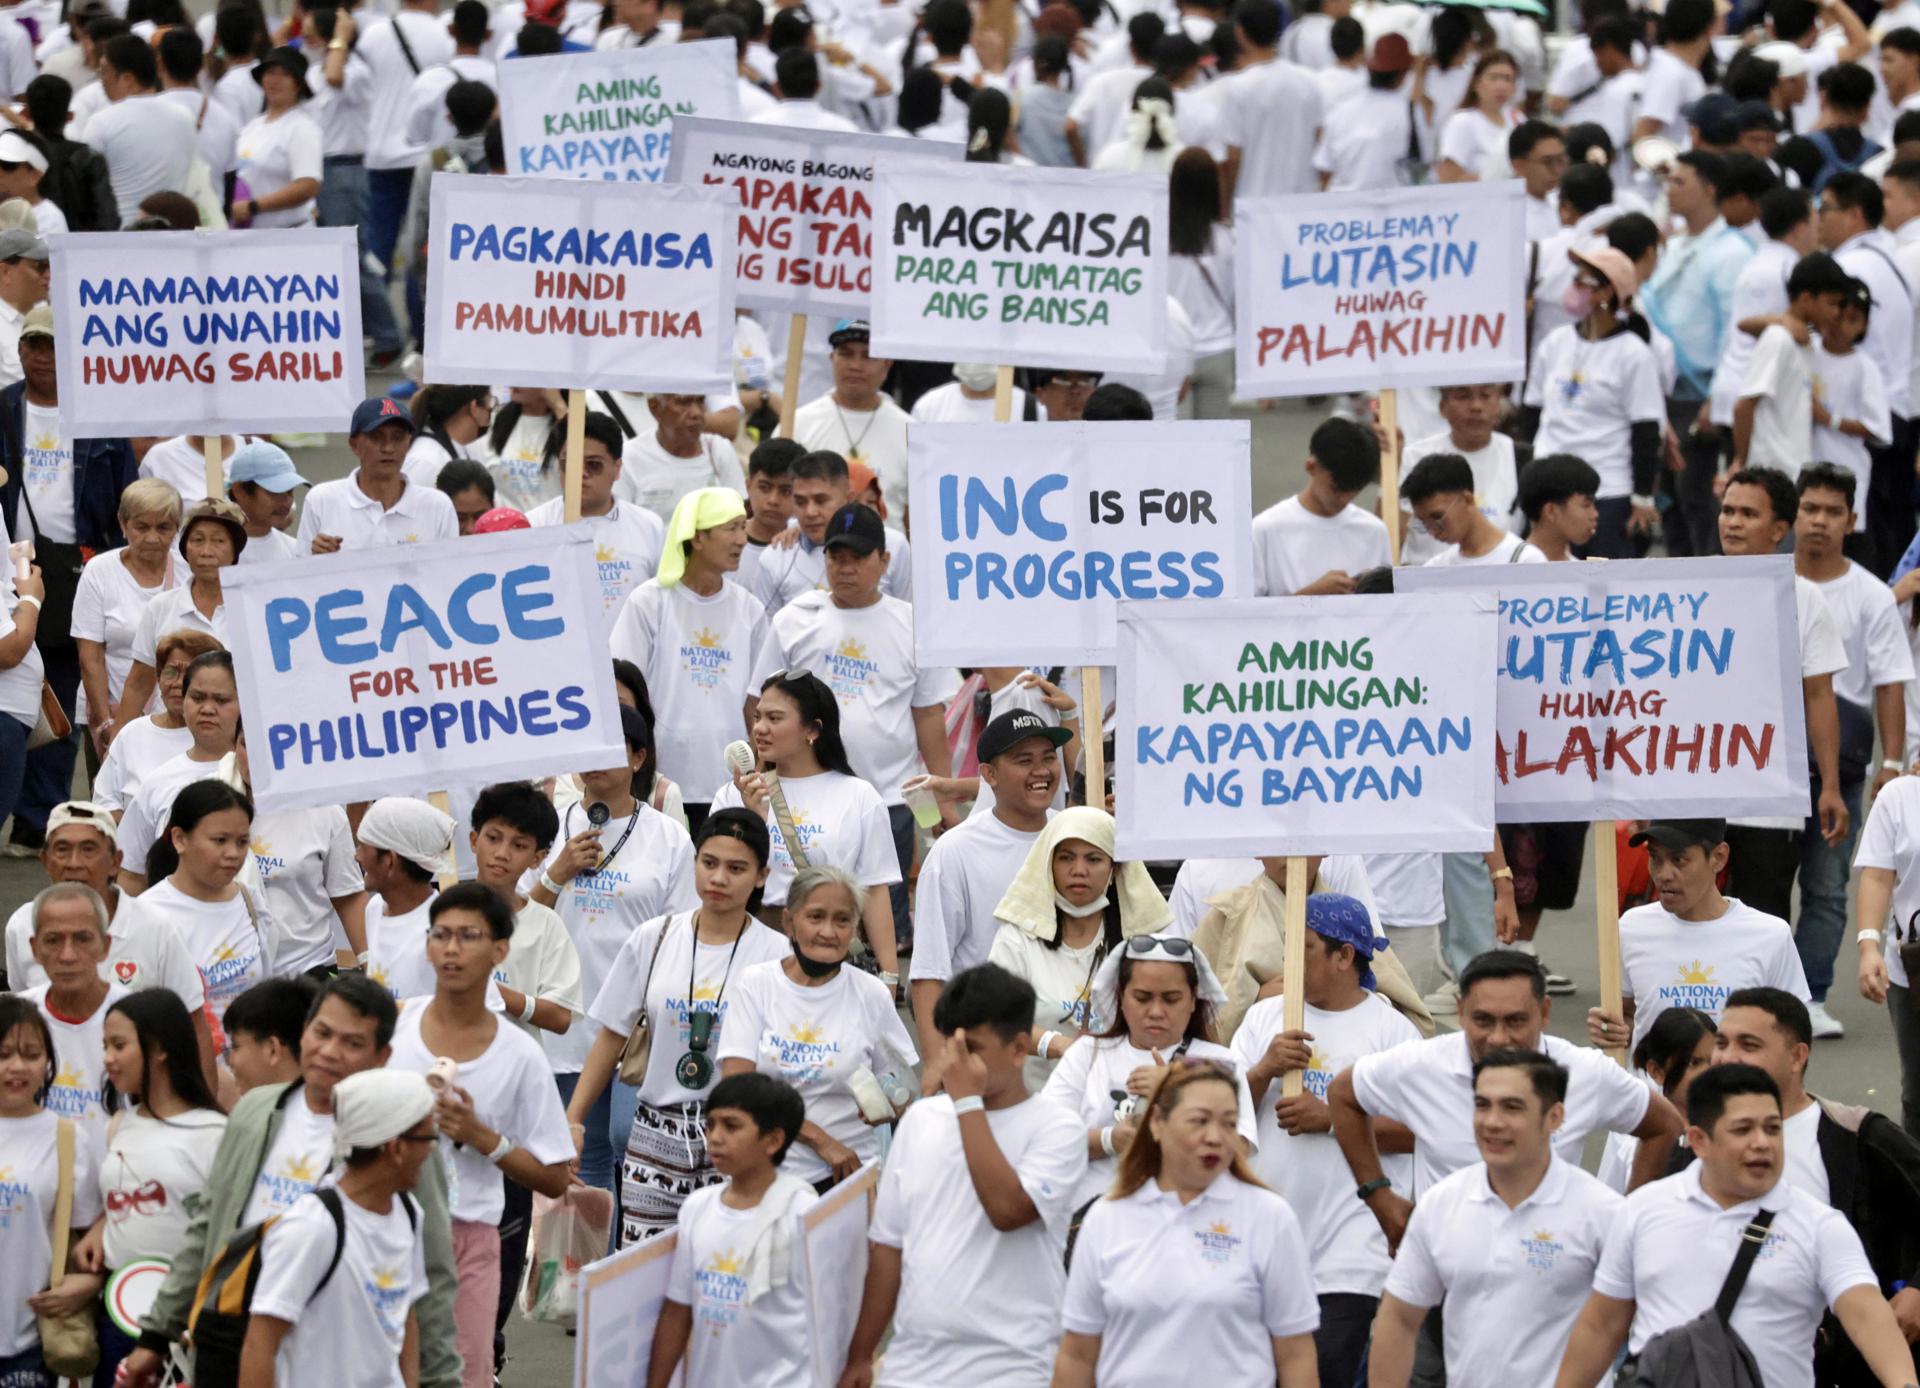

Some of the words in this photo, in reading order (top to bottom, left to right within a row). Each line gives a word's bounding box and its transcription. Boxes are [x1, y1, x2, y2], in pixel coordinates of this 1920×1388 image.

[577, 75, 662, 105] AMING
[713, 153, 795, 174] NGAYONG
[802, 160, 872, 181] BAGONG
[450, 223, 713, 268] PAGKAKAISA
[810, 222, 872, 257] TA
[893, 202, 1150, 257] MAGKAISA
[896, 255, 977, 286] PARA
[992, 260, 1142, 296] TUMATAG
[1281, 240, 1478, 290] LUTASIN
[80, 274, 339, 307] MAMAMAYAN
[535, 270, 625, 300] HINDI
[1336, 289, 1427, 314] HUWAG
[456, 303, 701, 337] PAMUMULITIKA
[923, 292, 989, 321] ANG
[1001, 298, 1109, 326] BANSA
[82, 311, 168, 348] ANG
[183, 309, 341, 345] UNAHIN
[1258, 313, 1505, 366] PALAKIHIN
[83, 351, 216, 385] HUWAG
[228, 351, 342, 382] SARILI
[939, 473, 1069, 543] INC
[1089, 490, 1125, 525] IS
[1139, 488, 1217, 527] FOR
[944, 550, 1224, 601] PROGRESS
[265, 564, 566, 672] PEACE
[681, 646, 732, 661] NATIONAL
[691, 657, 720, 669] RALLY
[825, 654, 879, 673] NATIONAL
[1237, 637, 1373, 673] AMING
[1497, 627, 1735, 685] UTASIN
[349, 668, 419, 703] FOR
[428, 657, 497, 690] THE
[833, 664, 867, 681] RALLY
[1183, 677, 1427, 714] KAHILINGAN:
[1539, 689, 1667, 720] HUWAG
[268, 686, 592, 771] PHILIPPINES
[1137, 717, 1472, 765] KAPAYAPAAN
[1183, 768, 1244, 807] NG
[1261, 764, 1423, 806] BAYAN
[575, 876, 617, 892] RALLY
[575, 896, 615, 911] PEACE
[771, 1035, 840, 1054] NATIONAL
[780, 1050, 826, 1063] RALLY
